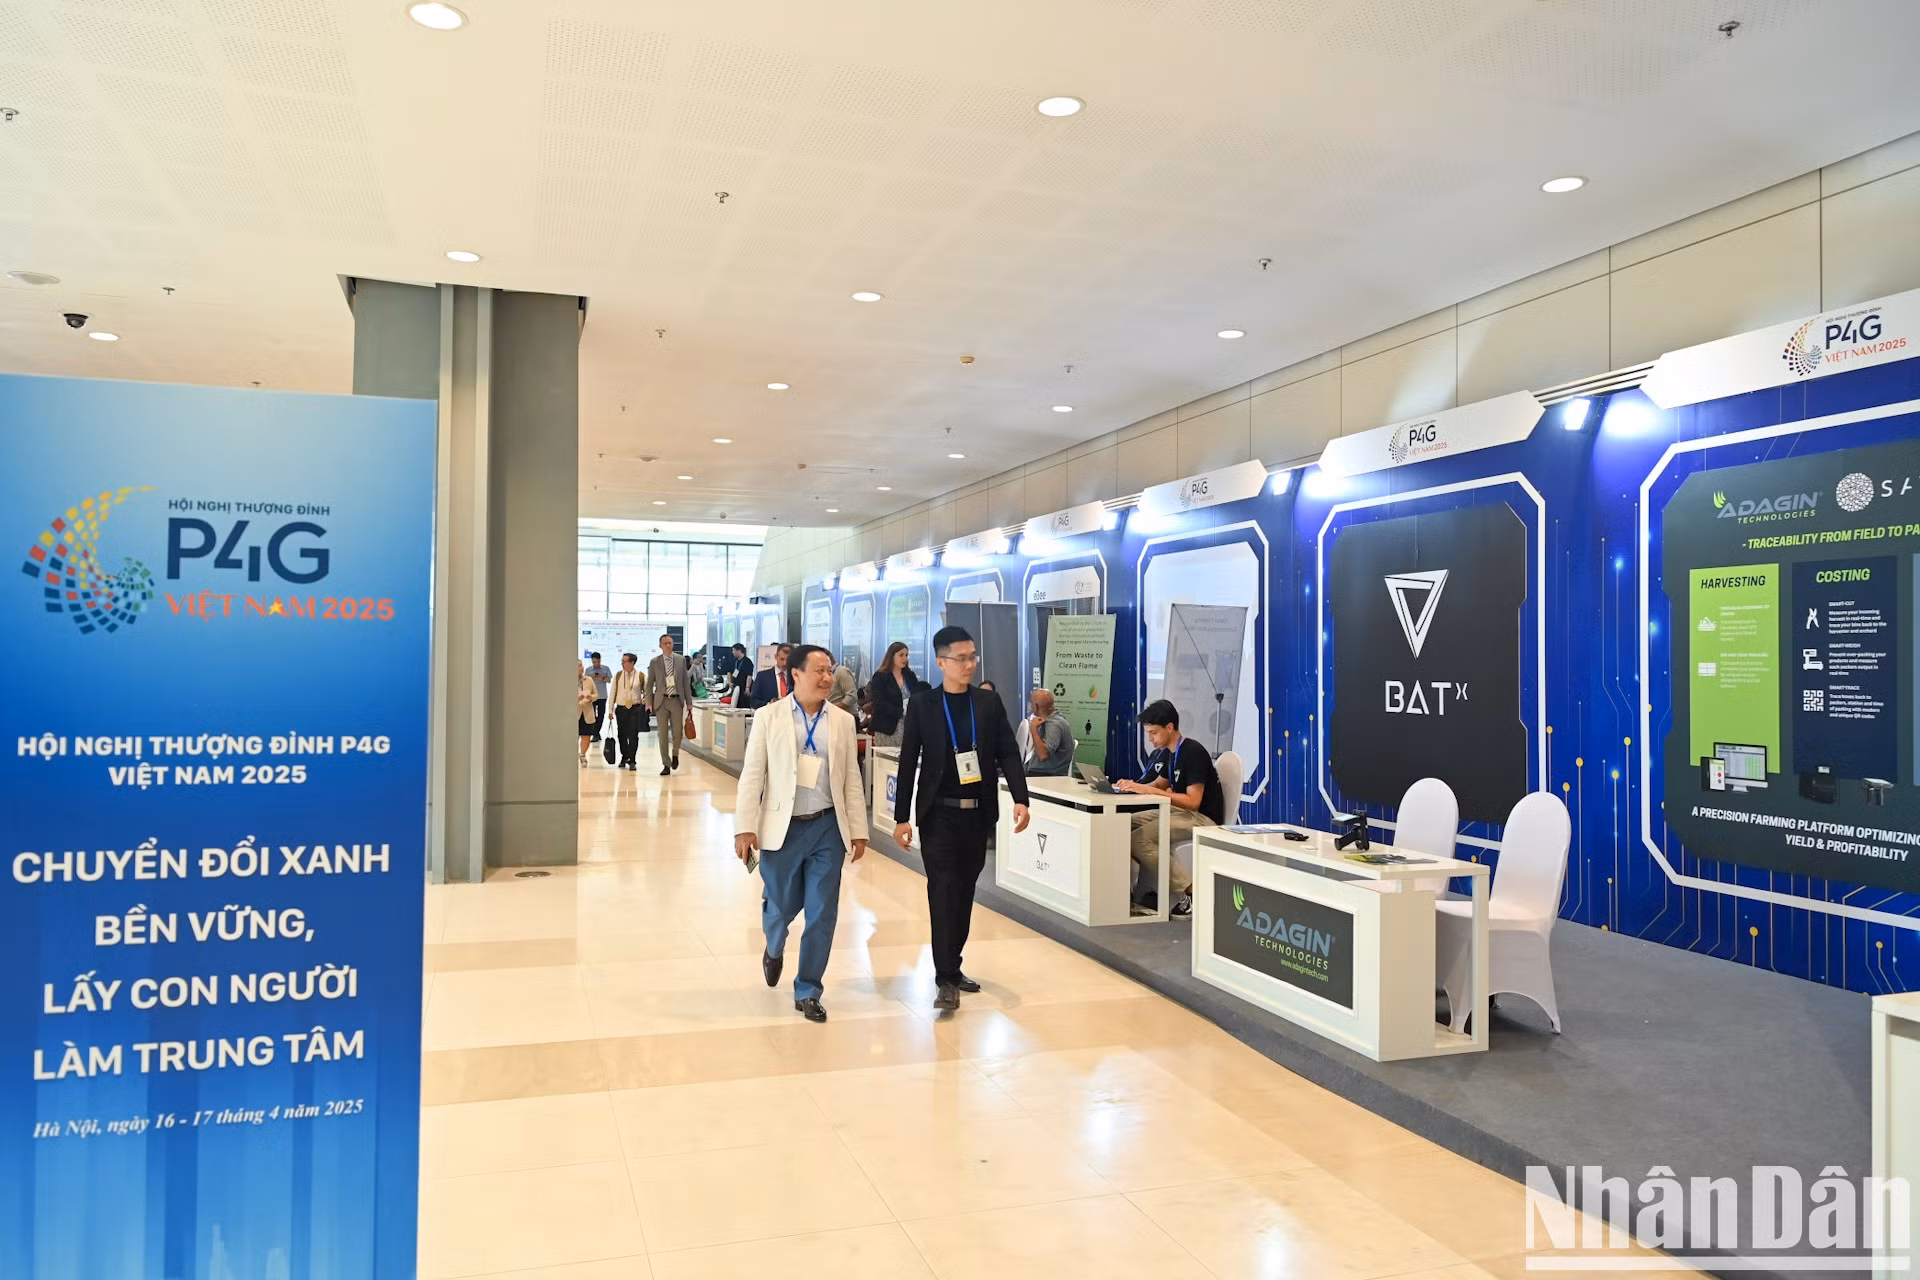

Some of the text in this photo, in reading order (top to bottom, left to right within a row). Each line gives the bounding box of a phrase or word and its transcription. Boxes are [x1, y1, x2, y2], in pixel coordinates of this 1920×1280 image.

[1826, 315, 1882, 350] P4G
[1825, 338, 1907, 364] VIỆT NAM 2025
[1409, 425, 1436, 446] P4G
[1192, 481, 1208, 496] P4G
[1881, 475, 1920, 497] SA
[169, 499, 331, 517] HỘI NGHỊ THƯỢNG ĐỈNH
[1738, 509, 1816, 524] TECHNOLOGIES
[166, 518, 330, 584] P4G
[1748, 532, 1819, 549] TRACEABILITY
[1820, 530, 1852, 543] FROM
[1854, 527, 1886, 540] FIELD
[1888, 525, 1903, 538] TO
[1701, 575, 1766, 590] HARVESTING
[1816, 568, 1871, 583] COSTING
[165, 590, 395, 622] VIỆT NAM 2025
[17, 731, 391, 761] HỘI NGHỊ THƯỢNG ĐỈNH P4G
[108, 762, 307, 790] VIỆT NAM 2025
[1692, 806, 1699, 816] A
[1700, 807, 1749, 823] PRECISION
[1750, 813, 1796, 830] FARMING
[1798, 819, 1854, 837] PLATFORM
[12, 835, 391, 884] CHUYỂN ĐỔI XANH
[1785, 834, 1909, 862] YIELD & PROFITABILITY
[95, 904, 315, 946] BỀN VỮNG,
[1255, 935, 1328, 970] TECHNOLOGIES
[1281, 959, 1328, 982] www.adagintech.com
[43, 963, 358, 1015] LẤY CON NGƯỜI
[33, 1026, 365, 1081] LÀM TRUNG TÂM
[32, 1122, 61, 1138] Hà
[64, 1119, 102, 1137] Nội,
[106, 1116, 150, 1136] ngày
[155, 1113, 176, 1129] 16
[191, 1111, 214, 1127] 17
[216, 1106, 265, 1126] tháng
[269, 1106, 280, 1119] 4
[283, 1103, 320, 1119] năm
[324, 1099, 364, 1116] 2025
